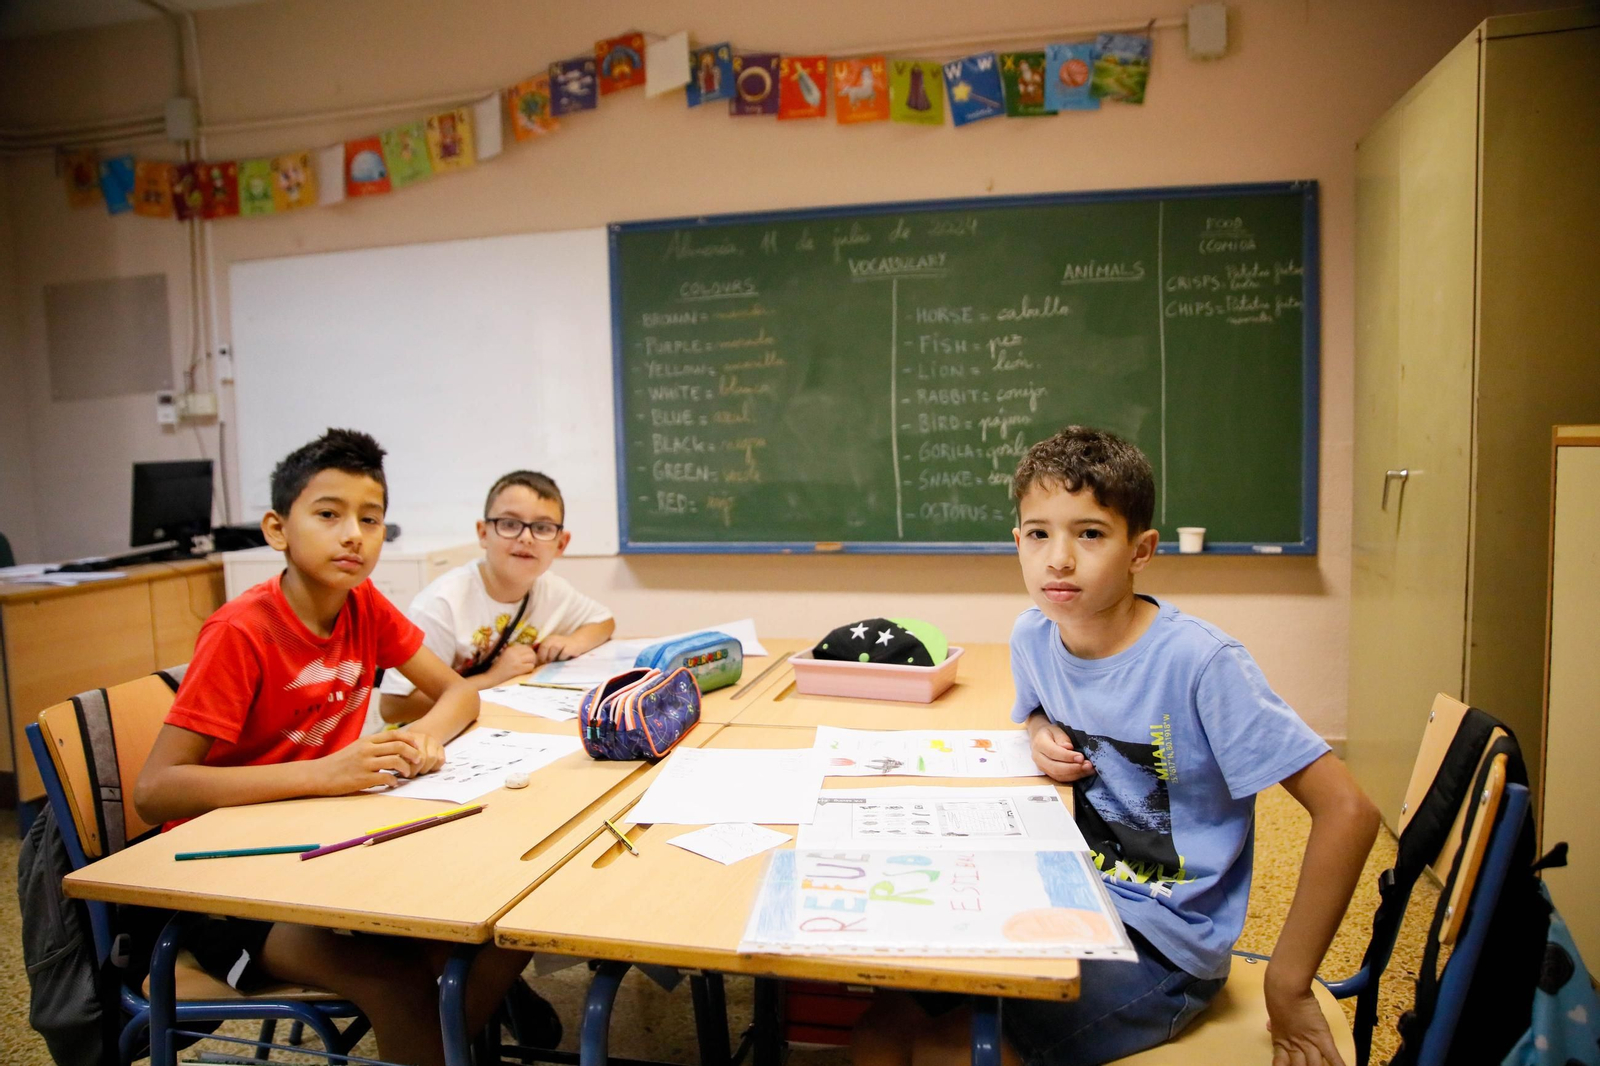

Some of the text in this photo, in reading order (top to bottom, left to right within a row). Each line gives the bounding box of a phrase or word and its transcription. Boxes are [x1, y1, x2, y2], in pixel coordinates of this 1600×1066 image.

[944, 62, 962, 80] W
[848, 252, 948, 275] VOCABULARY
[679, 277, 756, 297] COLOURS
[916, 306, 974, 325] HORSE
[647, 384, 702, 402] WHITE
[651, 407, 695, 426] BLUE
[1149, 723, 1170, 781] MIAMI
